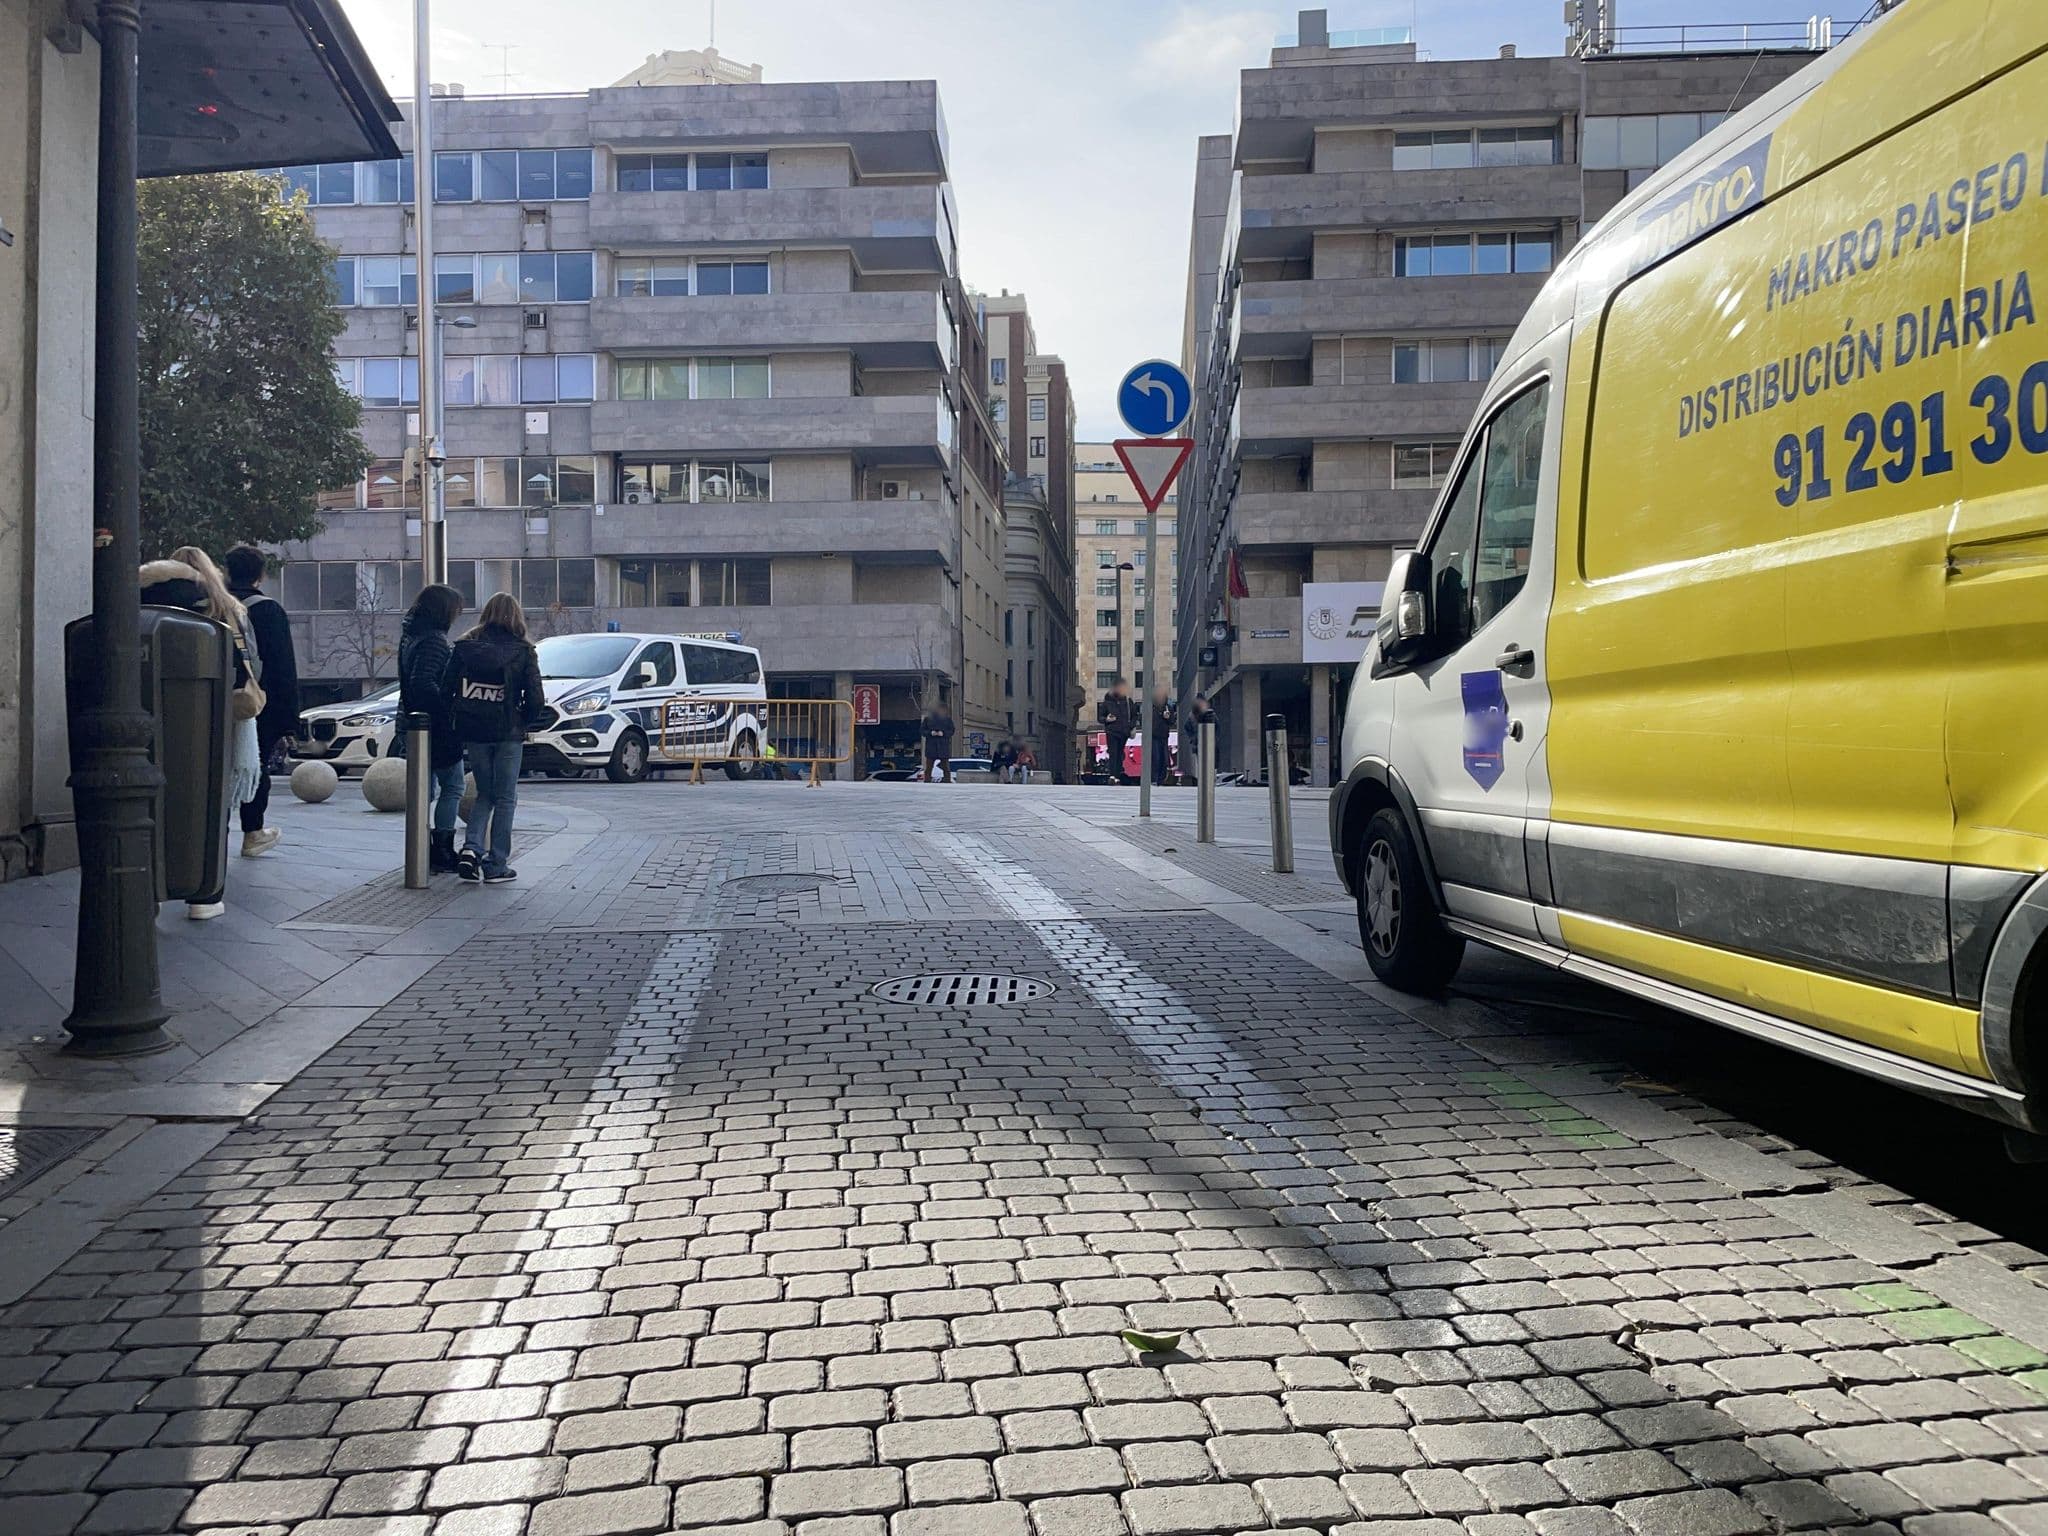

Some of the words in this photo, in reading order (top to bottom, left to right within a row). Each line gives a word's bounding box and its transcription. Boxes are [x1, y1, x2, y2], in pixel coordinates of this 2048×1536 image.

[1766, 217, 1882, 312] MAKRO
[1892, 151, 2028, 258] PASEO
[1678, 318, 1884, 438] DISTRIBUCIÓN
[1895, 271, 2036, 367] DIARIA
[1774, 426, 1832, 507] 91
[1844, 391, 1954, 494] 291
[1969, 360, 2048, 465] 30
[462, 678, 505, 702] VANS
[862, 691, 871, 719] BAZAR
